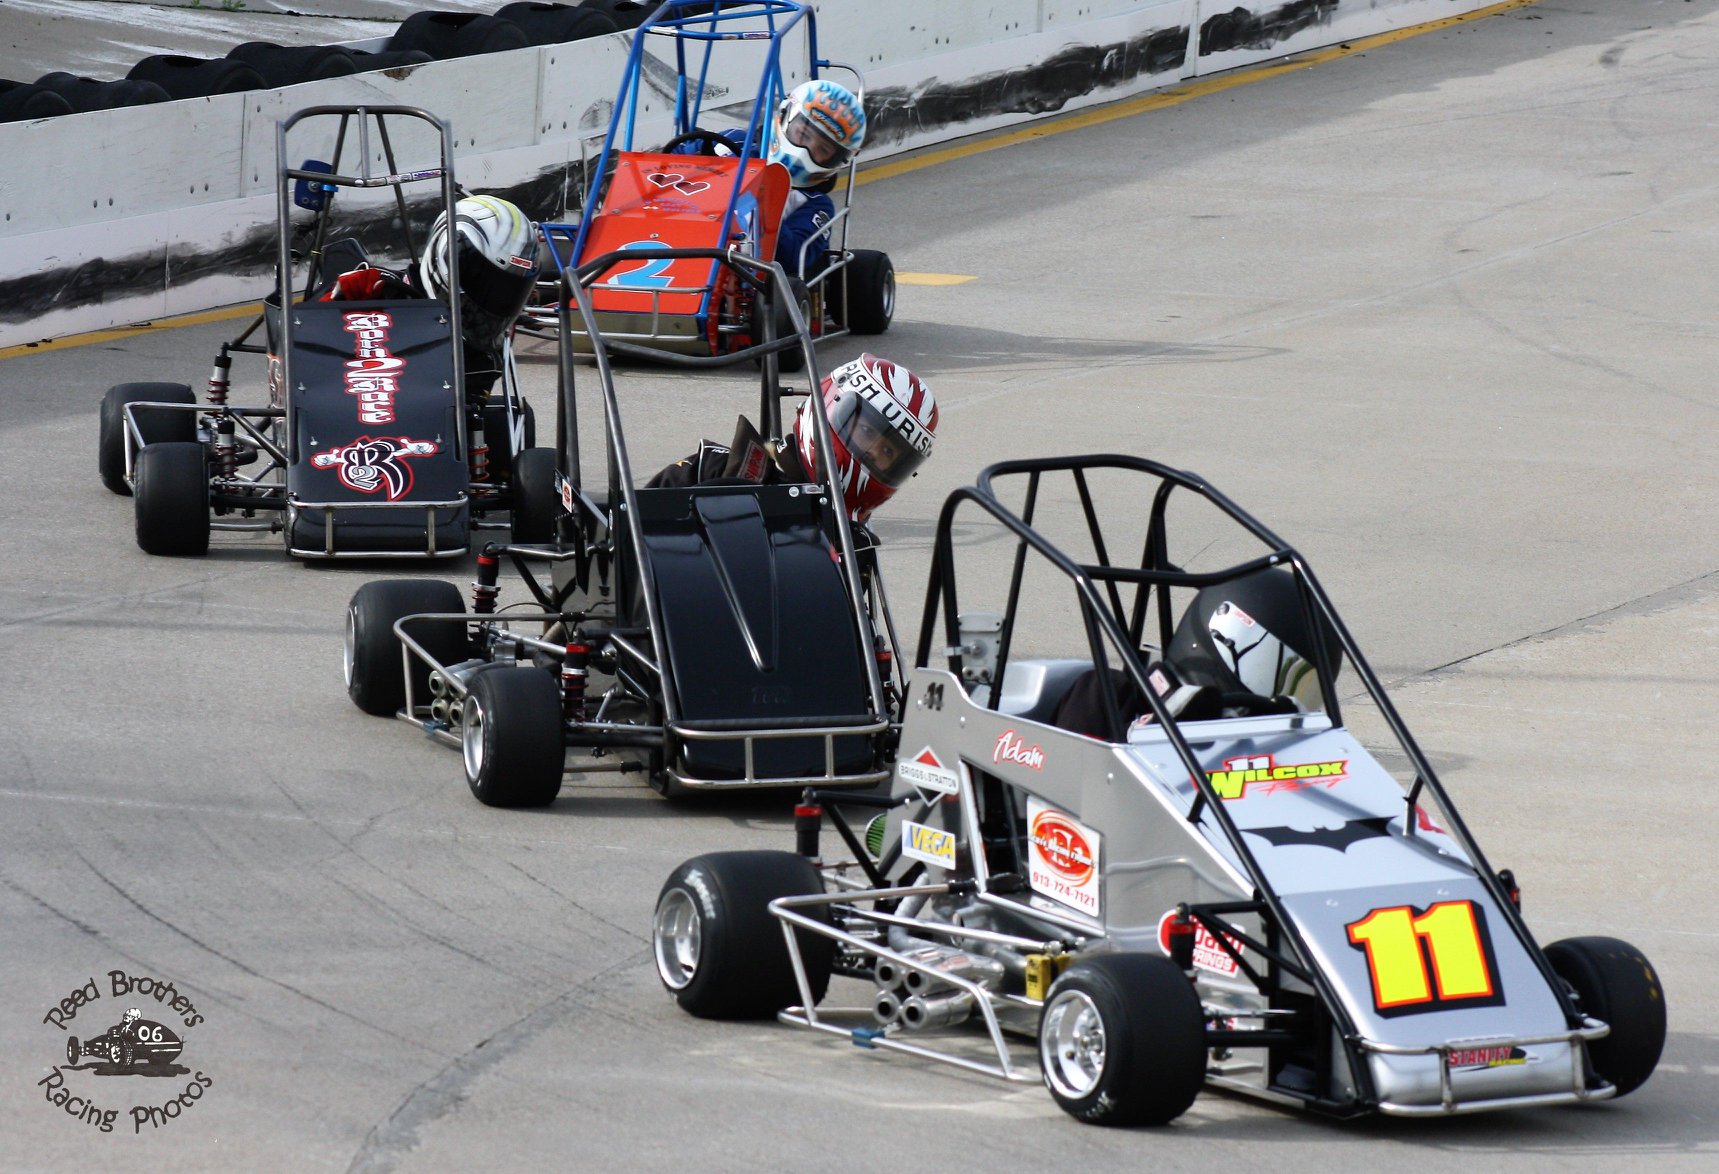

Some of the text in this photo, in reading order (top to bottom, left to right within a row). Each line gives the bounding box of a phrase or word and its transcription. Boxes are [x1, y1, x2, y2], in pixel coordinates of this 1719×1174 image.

[606, 240, 676, 293] 2
[993, 730, 1045, 770] Adam
[1228, 756, 1271, 771] 11
[909, 824, 956, 861] VEGA
[1345, 899, 1501, 1013] 11
